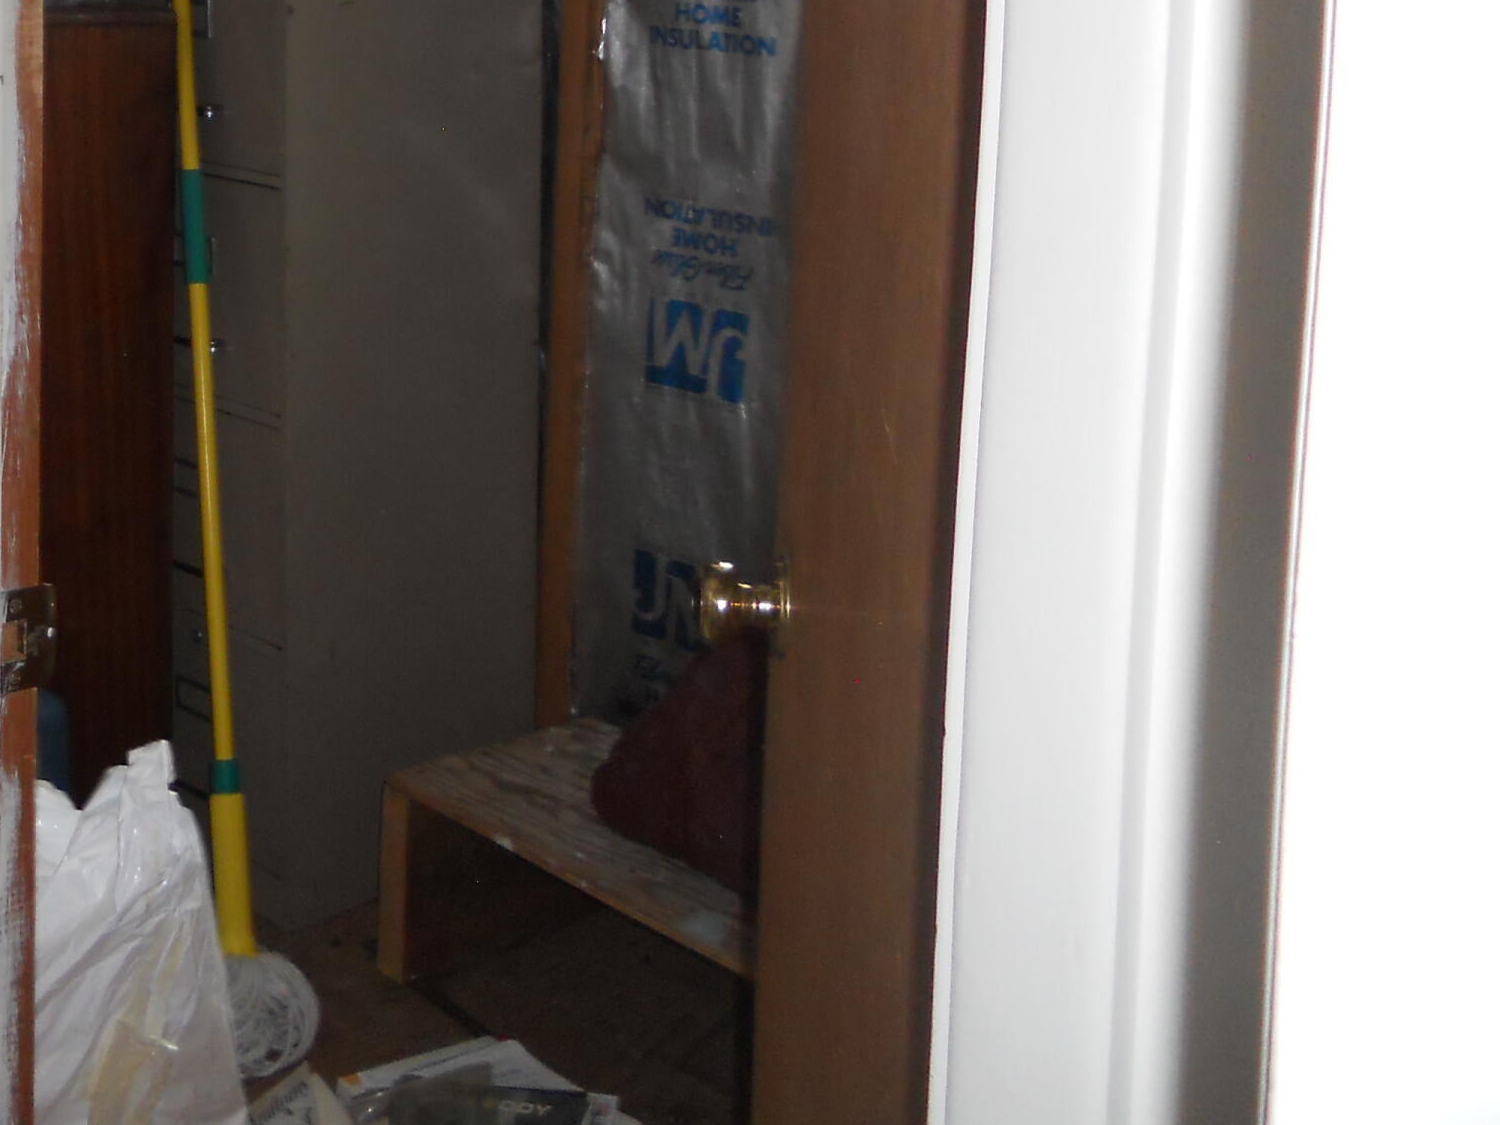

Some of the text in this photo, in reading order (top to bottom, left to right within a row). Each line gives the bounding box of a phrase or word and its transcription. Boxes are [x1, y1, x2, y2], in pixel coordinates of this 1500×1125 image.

[675, 2, 742, 27] HOME
[671, 226, 739, 259] HOME
[644, 297, 750, 404] JM
